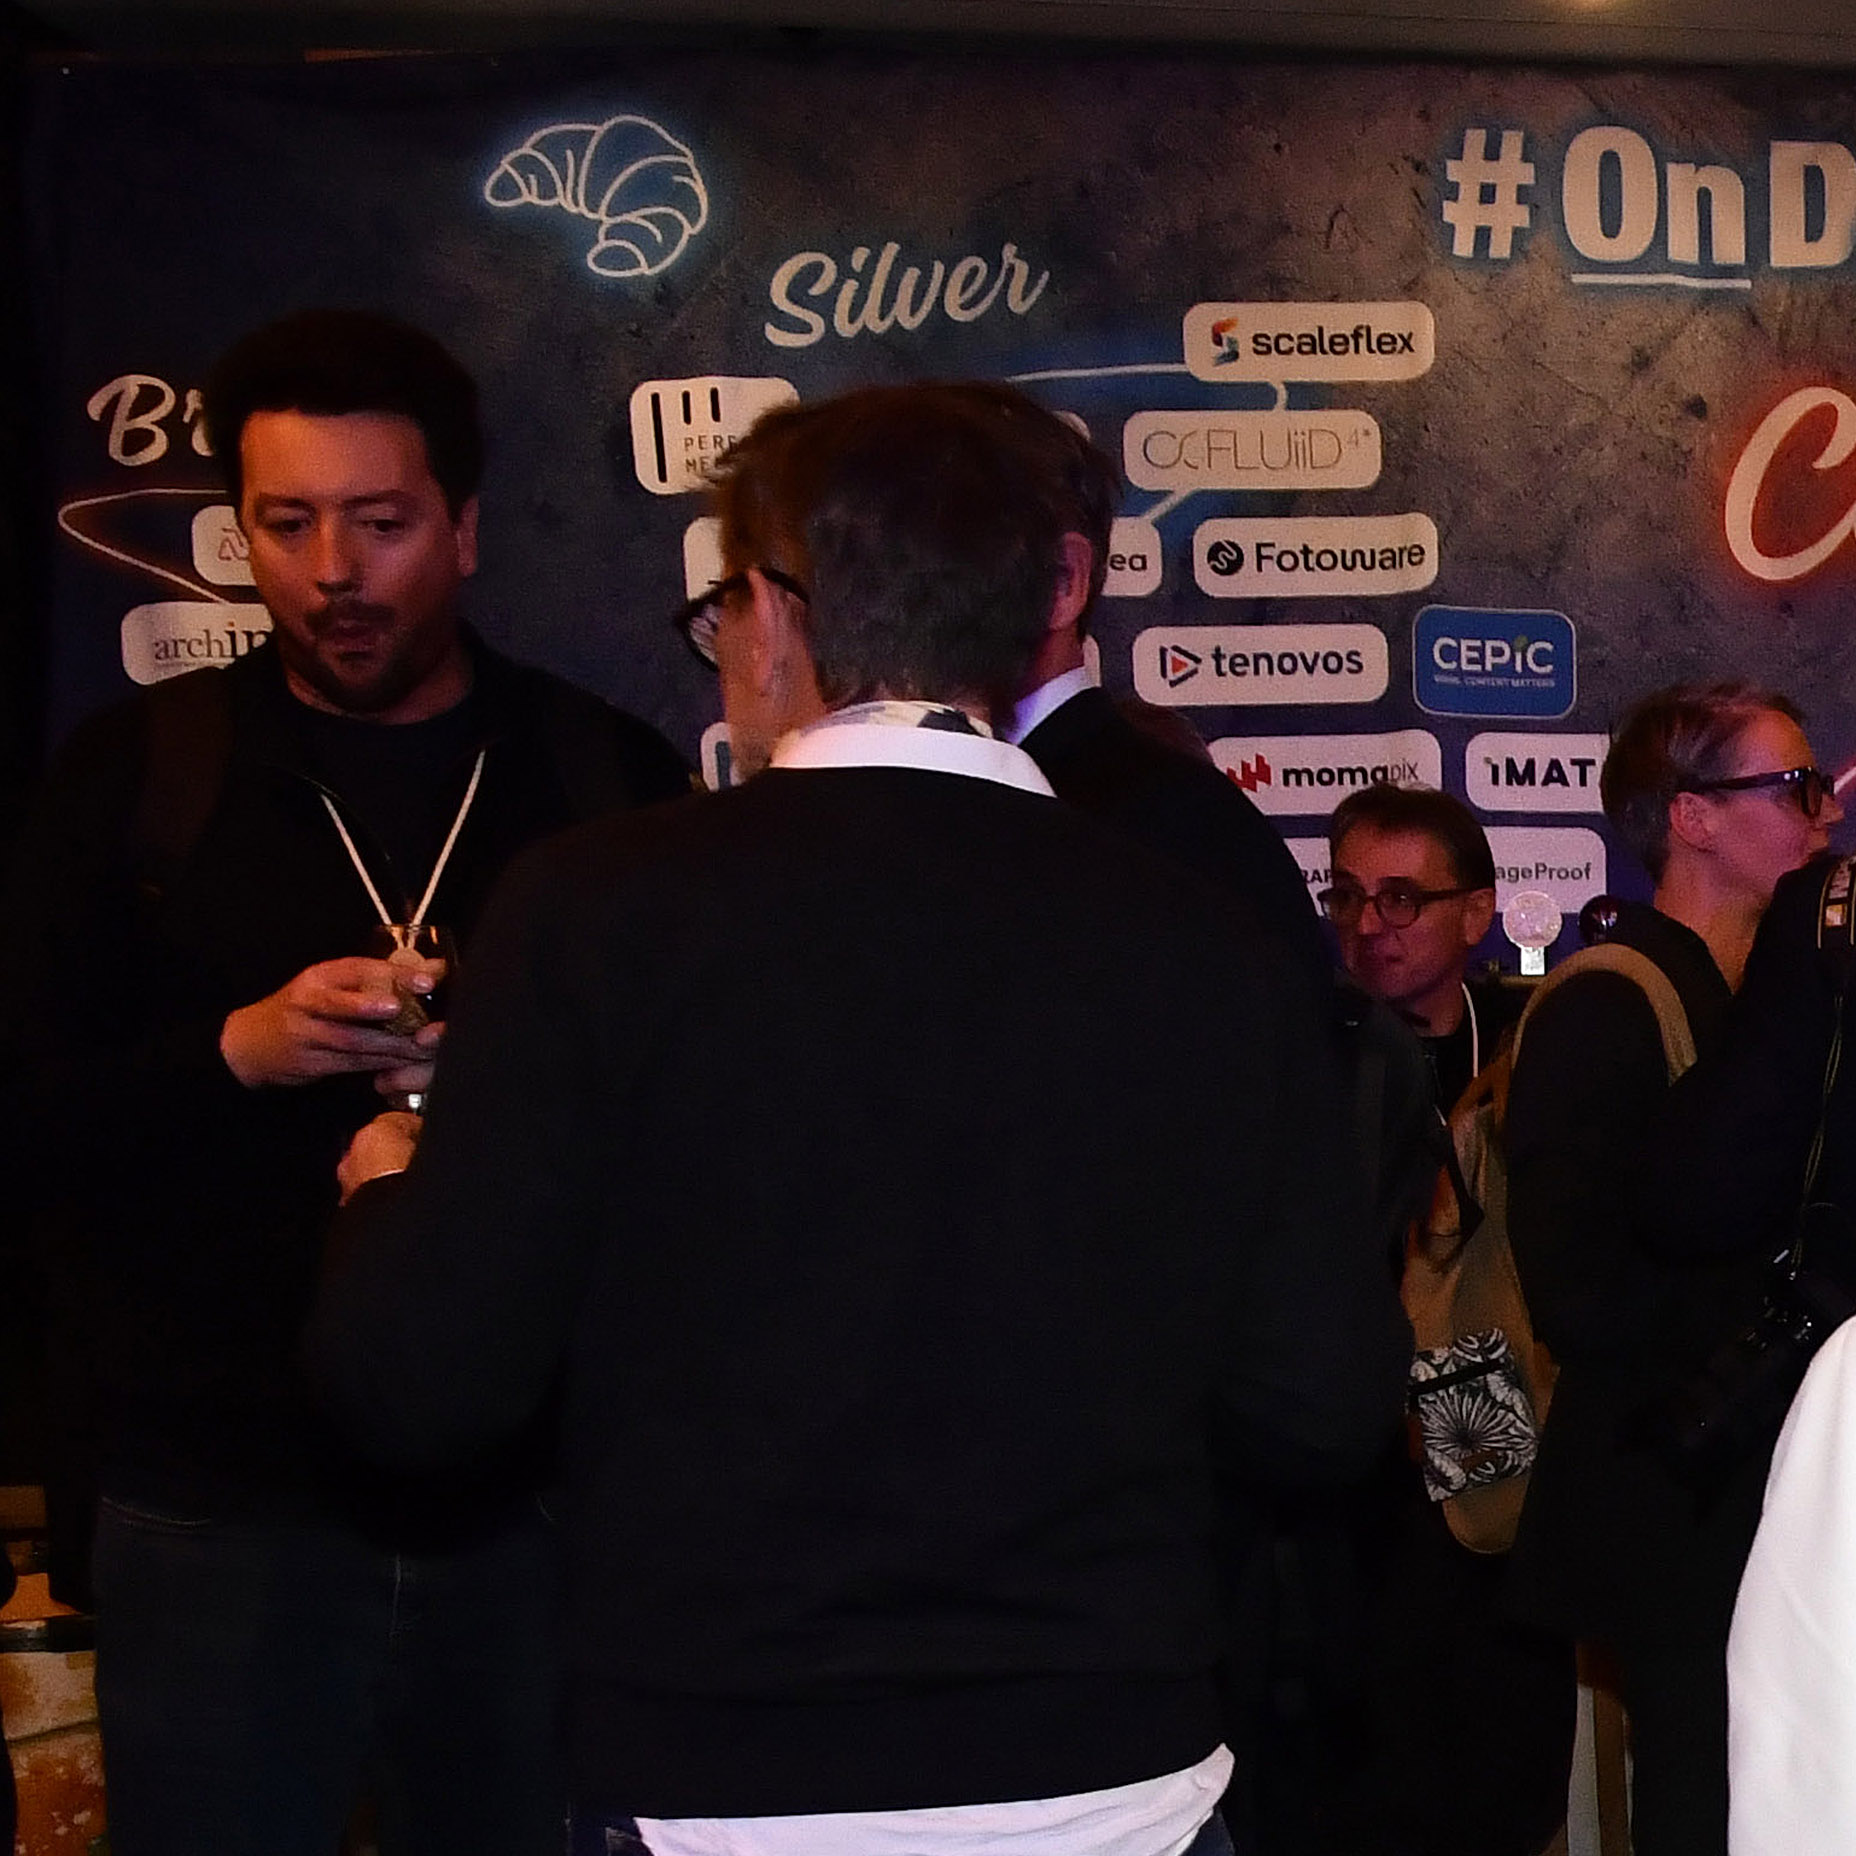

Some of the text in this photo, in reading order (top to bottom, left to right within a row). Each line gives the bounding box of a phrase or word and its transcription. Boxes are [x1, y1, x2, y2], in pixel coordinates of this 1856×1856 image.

[765, 242, 1050, 347] Silver
[1251, 324, 1415, 359] scaleflex
[1109, 553, 1147, 571] ea
[1255, 541, 1426, 573] Fotoware
[1211, 645, 1365, 679] tenovos
[1494, 861, 1592, 884] ageProof
